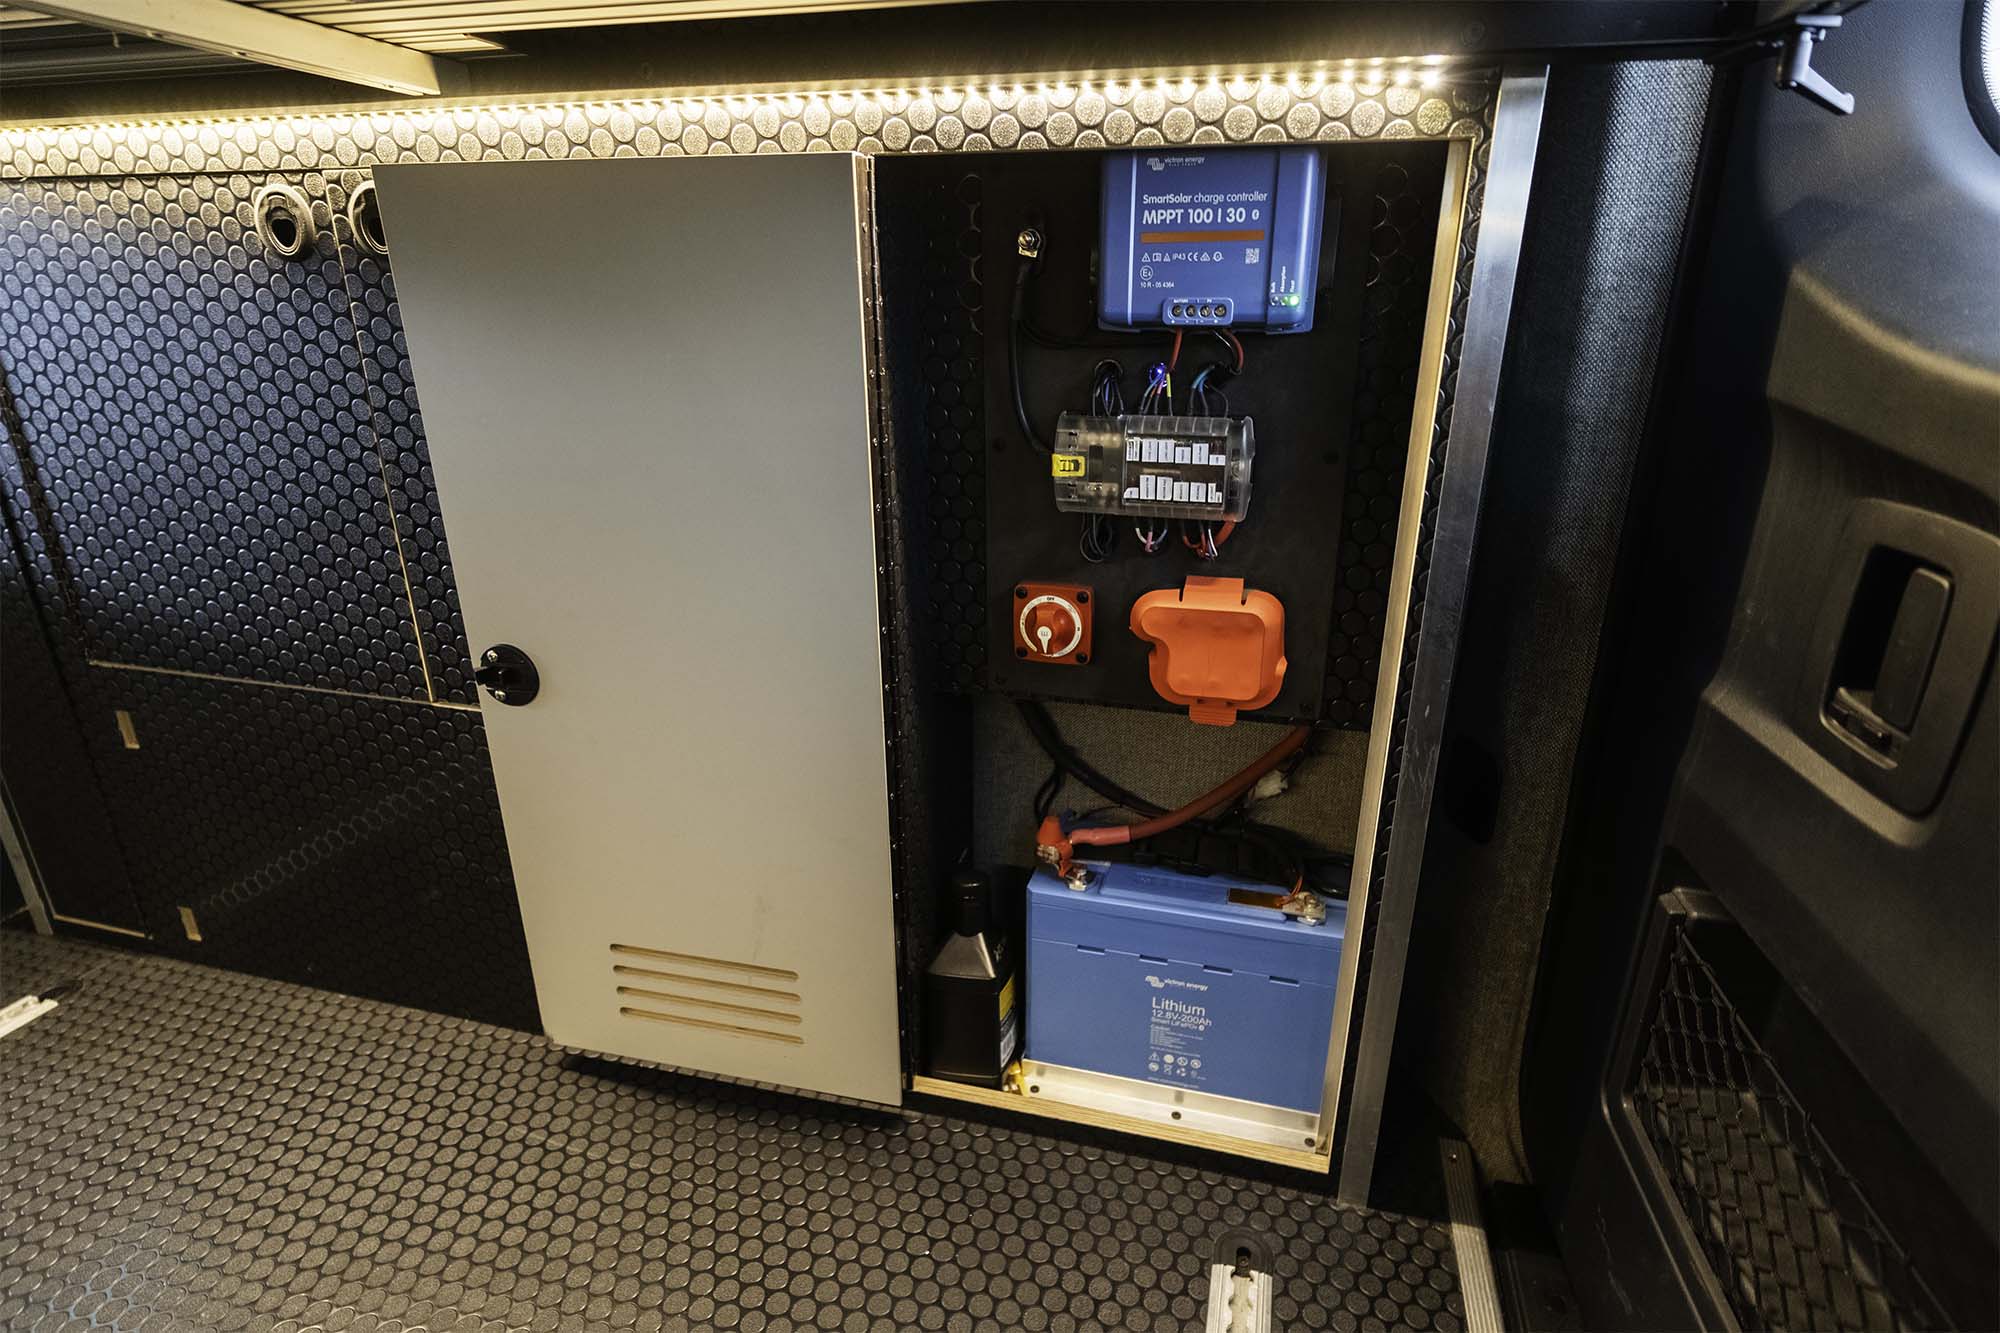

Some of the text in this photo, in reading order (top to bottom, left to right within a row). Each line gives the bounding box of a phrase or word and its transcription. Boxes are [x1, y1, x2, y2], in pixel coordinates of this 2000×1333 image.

[1142, 191, 1268, 205] SmartSolar charge controller
[1142, 208, 1185, 225] MPPT
[1188, 207, 1214, 224] 100
[1226, 207, 1247, 223] 30
[1152, 996, 1206, 1017] Lithium
[1152, 1008, 1212, 1027] 12.8V-200Ah
